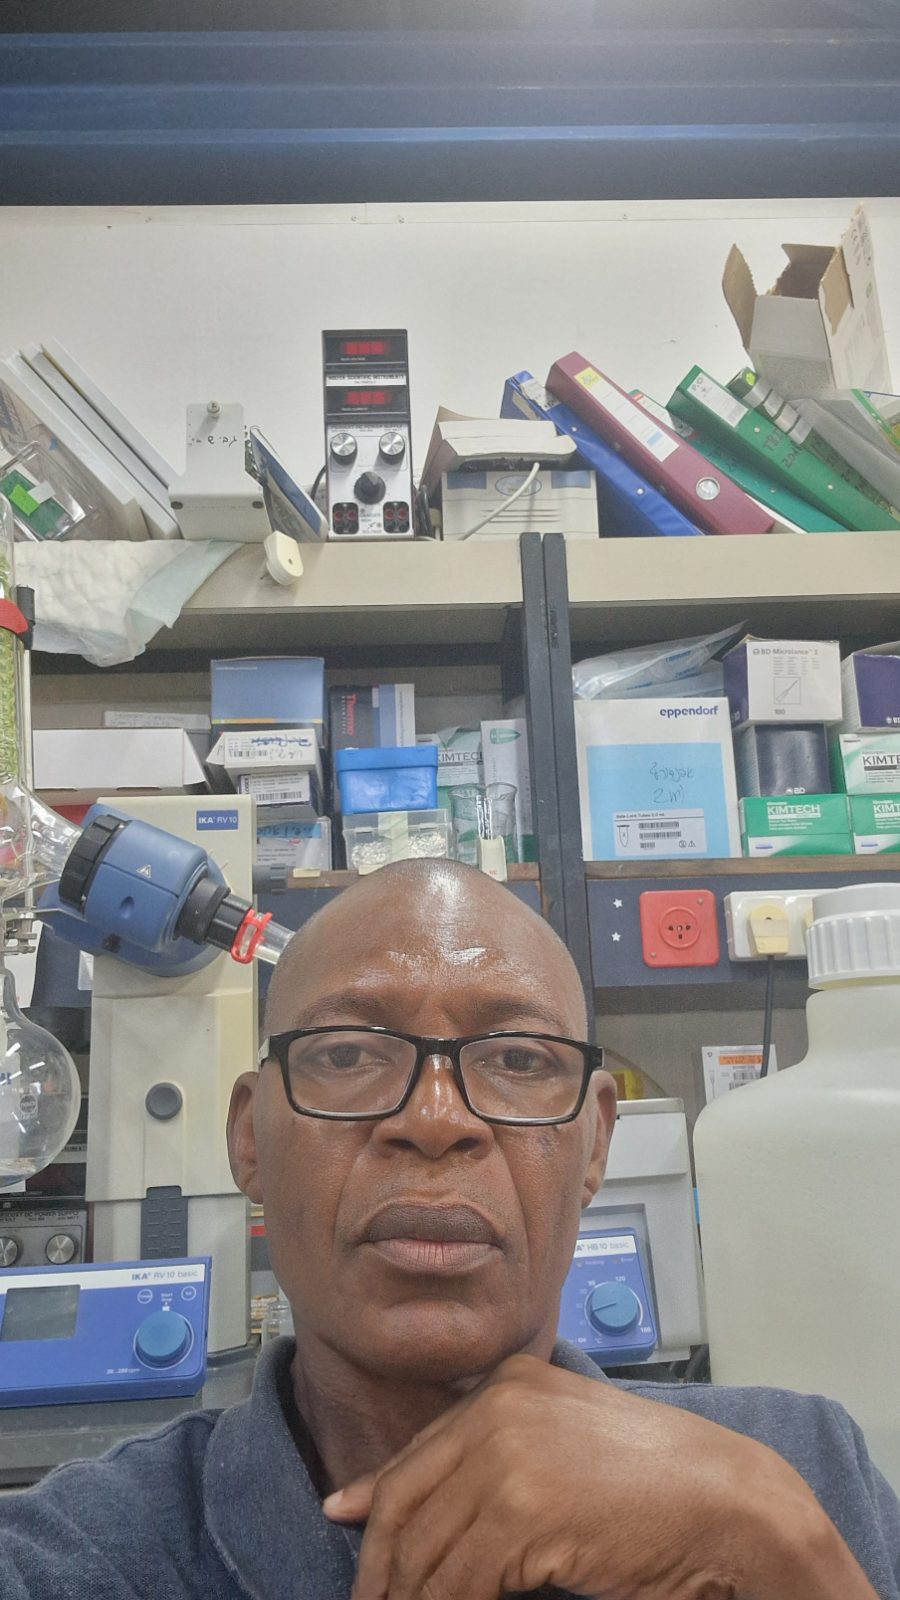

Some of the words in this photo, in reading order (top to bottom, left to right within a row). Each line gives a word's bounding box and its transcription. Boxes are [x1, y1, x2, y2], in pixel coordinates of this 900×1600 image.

[345, 691, 357, 736] Thermo
[659, 705, 719, 718] eppendorf
[767, 804, 821, 815] KIMTECH
[217, 816, 229, 824] RV
[167, 1270, 175, 1279] 10
